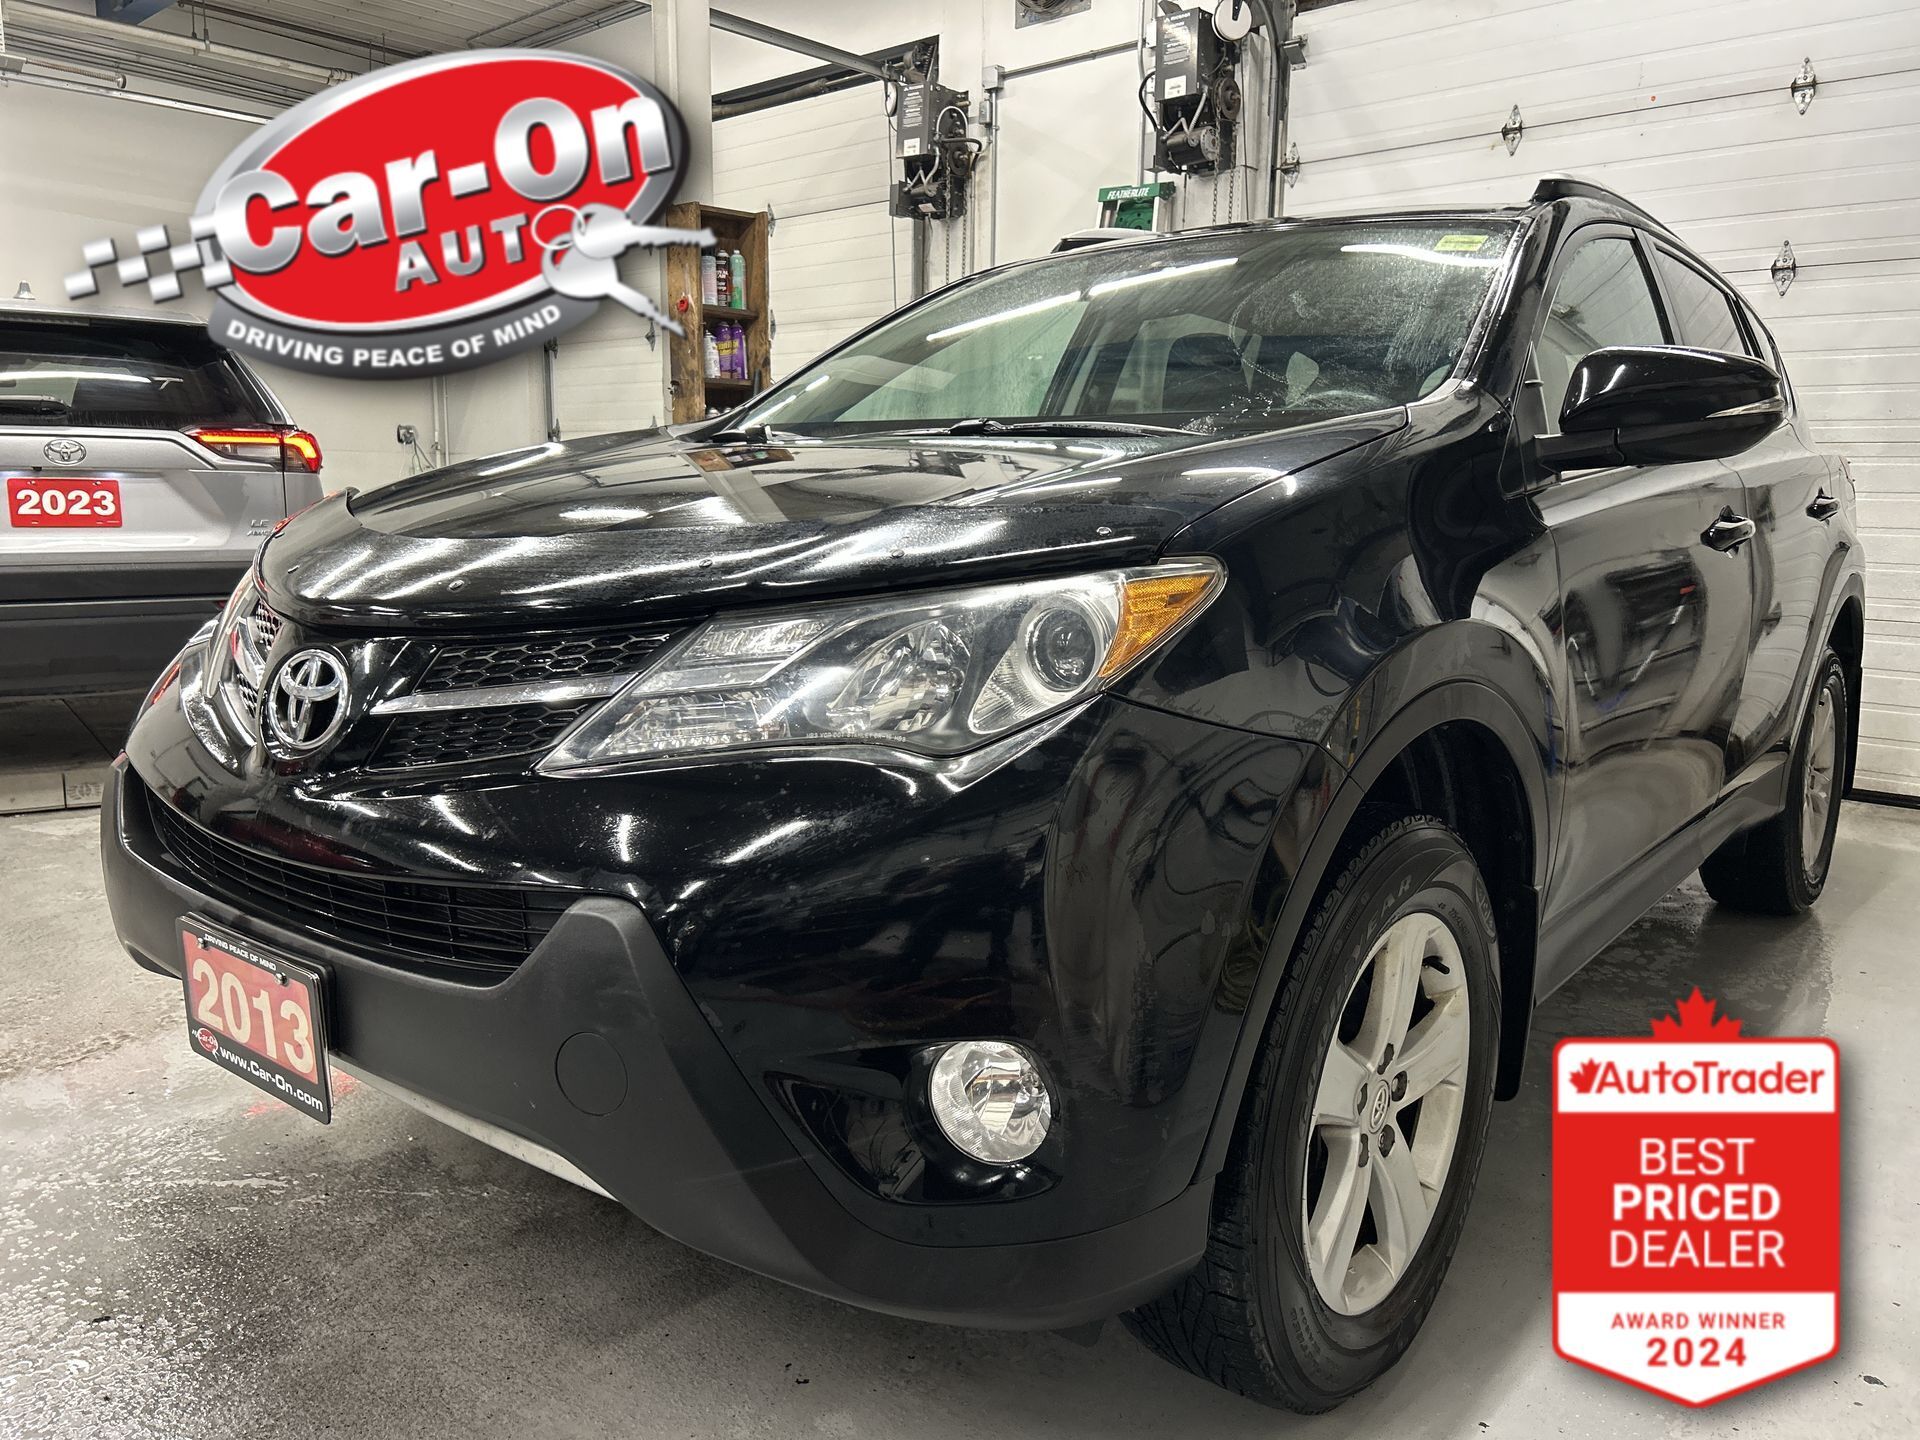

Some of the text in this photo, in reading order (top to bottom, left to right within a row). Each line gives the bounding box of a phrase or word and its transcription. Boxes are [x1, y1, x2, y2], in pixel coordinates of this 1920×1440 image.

[1106, 187, 1151, 200] FEATHERLITE
[16, 489, 116, 516] 2023
[204, 933, 277, 971] DRIVING PEACE OF MIND
[192, 958, 314, 1074] 2013
[219, 1046, 324, 1112] www.Car-On.com
